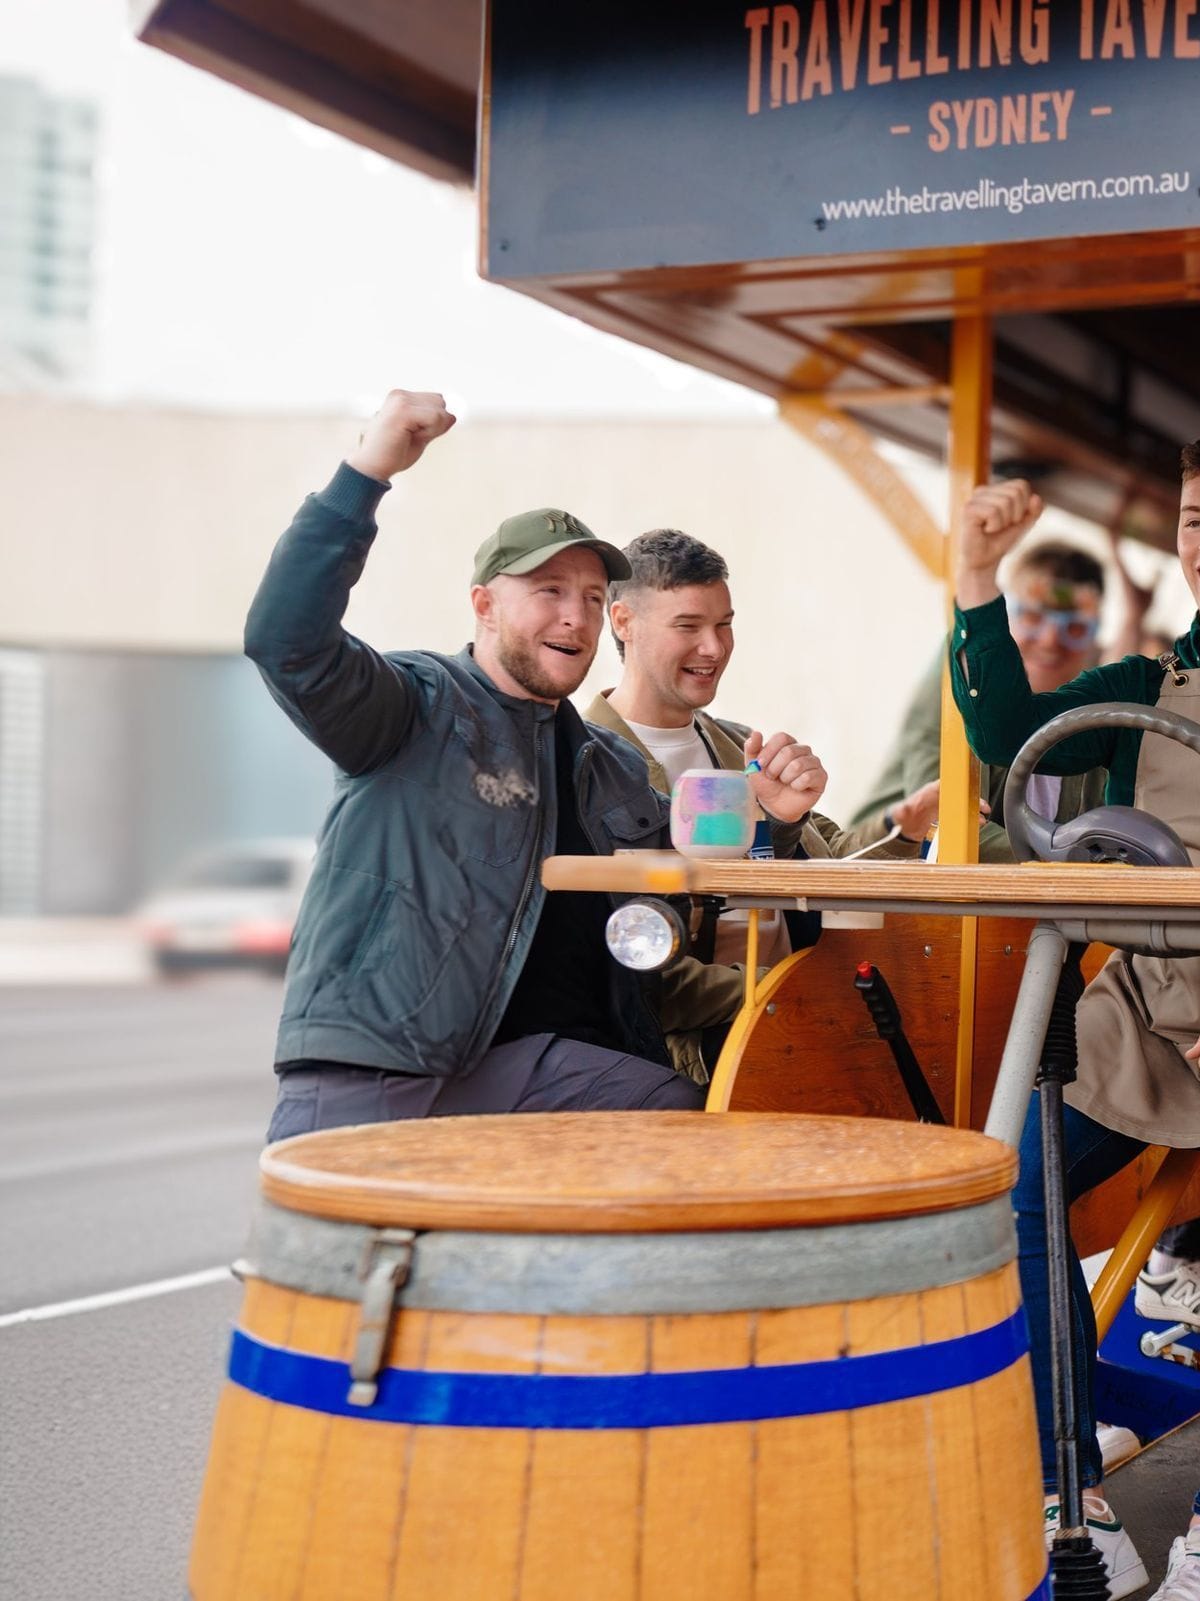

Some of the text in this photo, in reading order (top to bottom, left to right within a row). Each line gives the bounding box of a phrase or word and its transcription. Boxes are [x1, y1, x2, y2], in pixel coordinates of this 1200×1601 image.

[744, 0, 1049, 116] TRAVELLING
[928, 90, 1075, 152] SYDNEY
[821, 169, 1190, 221] www.thetravellingtavern.com.au
